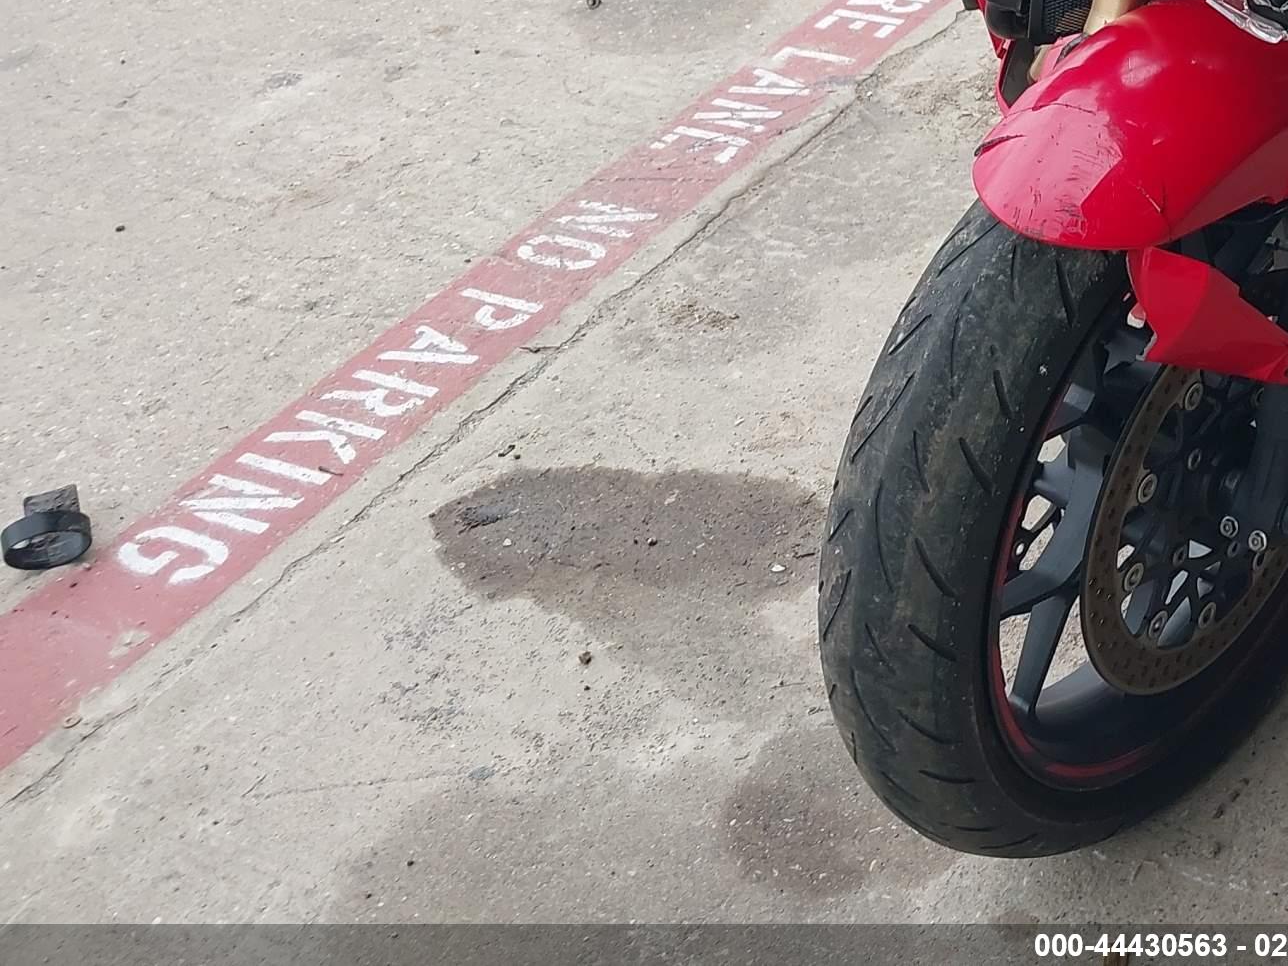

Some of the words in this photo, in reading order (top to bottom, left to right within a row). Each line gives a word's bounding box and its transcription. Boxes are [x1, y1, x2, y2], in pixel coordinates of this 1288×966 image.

[649, 46, 856, 164] LANE
[516, 200, 658, 270] NO
[115, 287, 543, 585] PARKING
